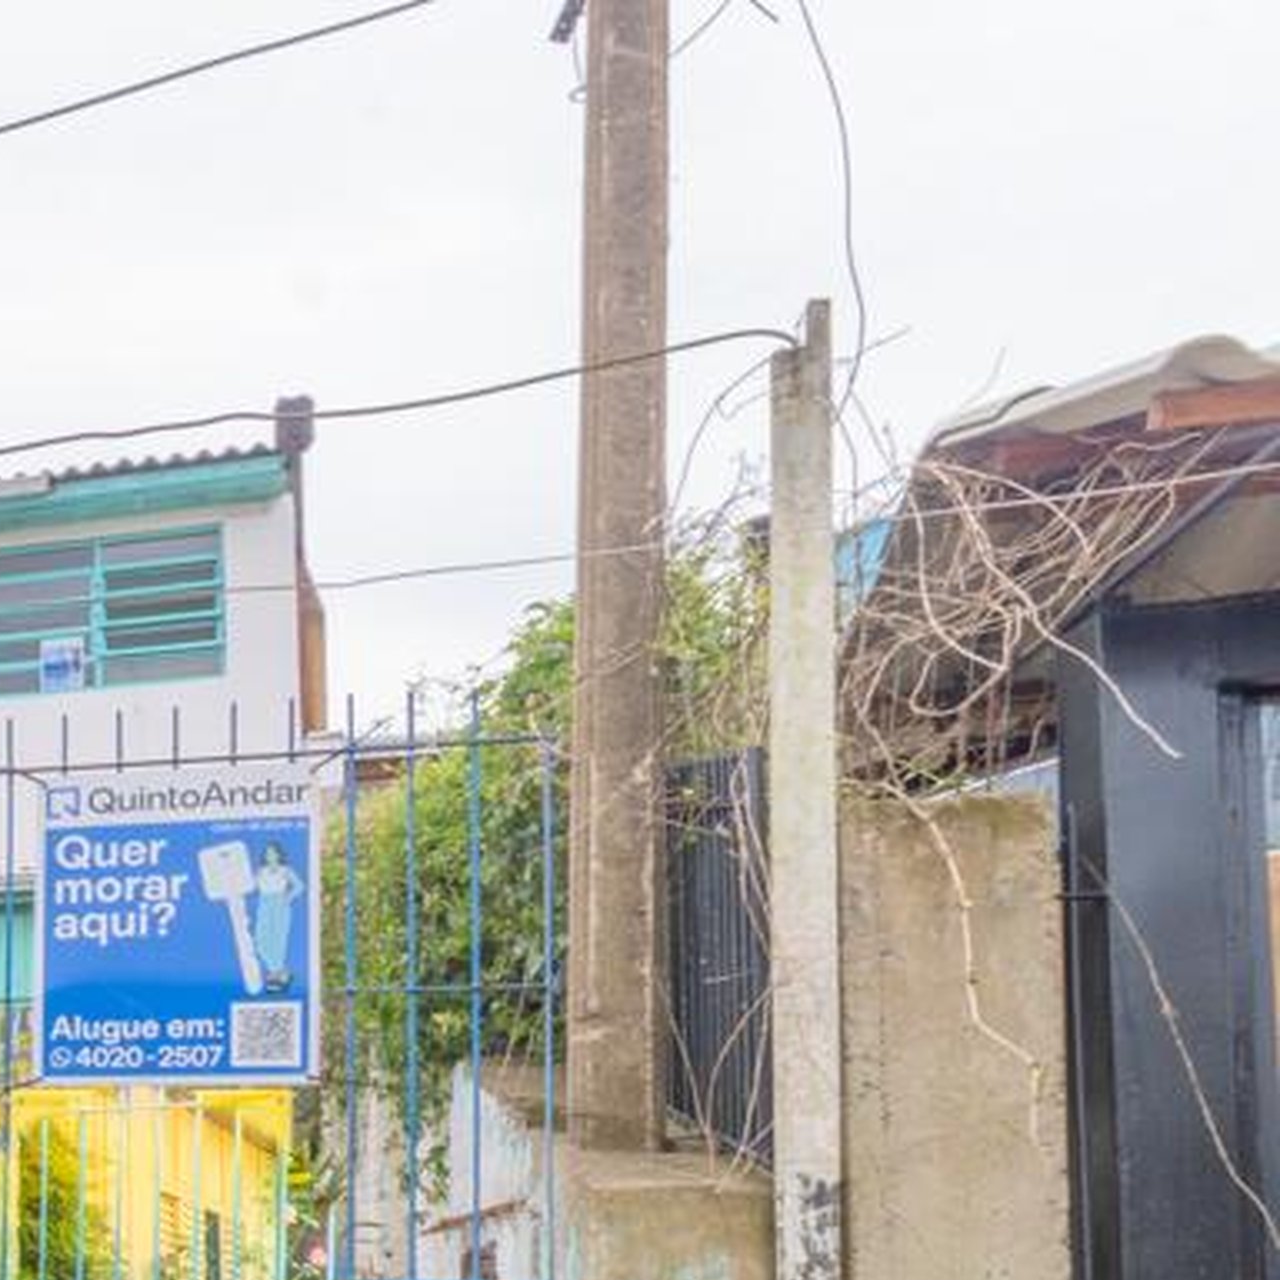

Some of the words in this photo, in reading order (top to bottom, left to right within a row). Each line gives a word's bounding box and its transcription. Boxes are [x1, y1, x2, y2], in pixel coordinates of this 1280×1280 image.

[88, 780, 308, 814] QuintoAndar
[54, 834, 166, 870] Quer
[54, 874, 187, 903] morar
[53, 902, 176, 946] aqui?
[51, 1015, 160, 1045] Alugue
[166, 1018, 225, 1039] em:
